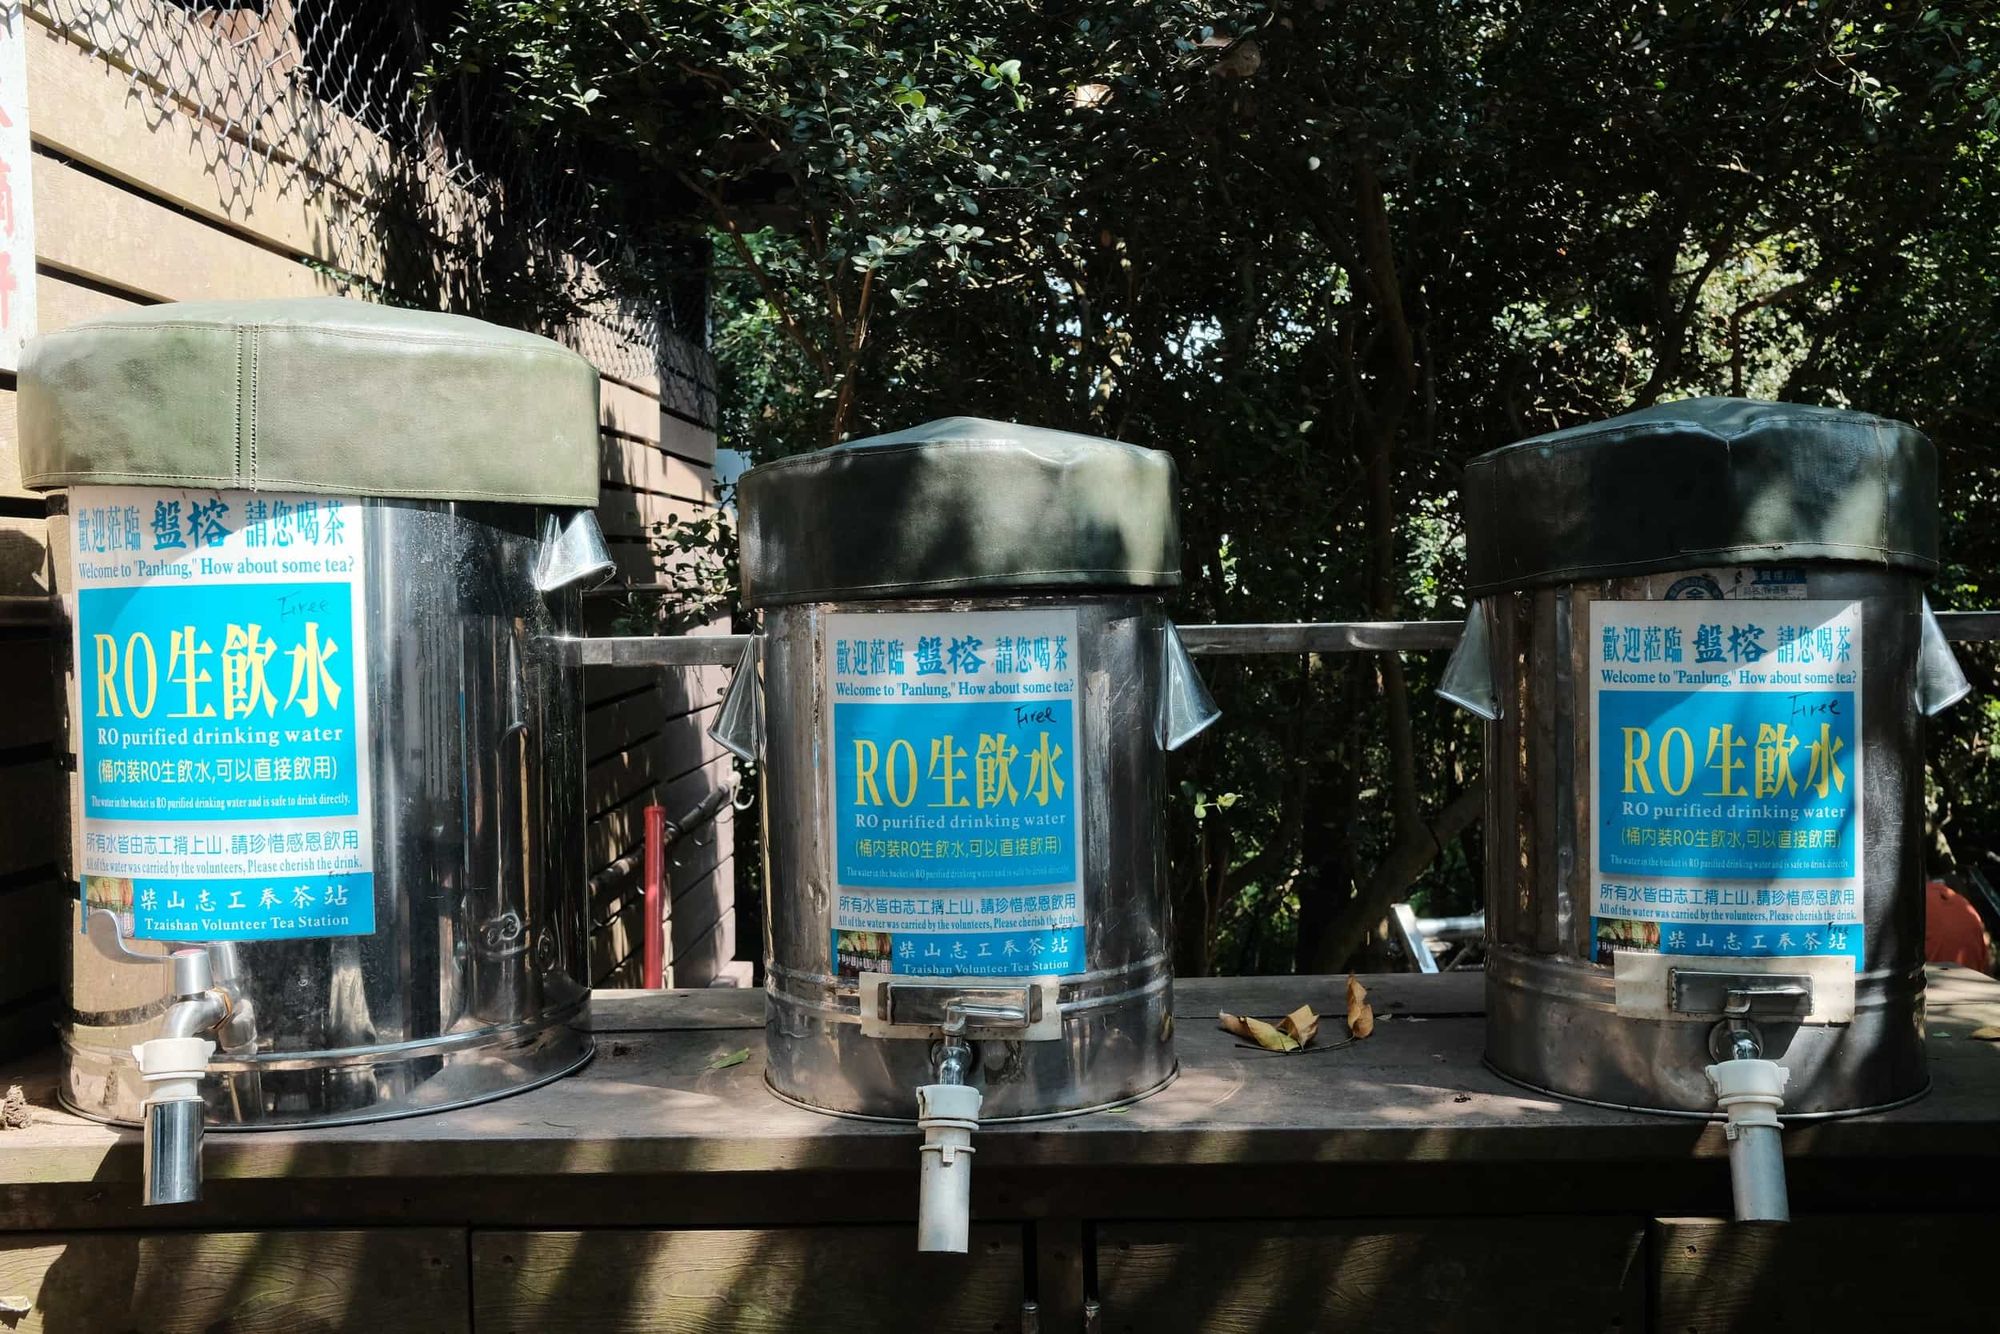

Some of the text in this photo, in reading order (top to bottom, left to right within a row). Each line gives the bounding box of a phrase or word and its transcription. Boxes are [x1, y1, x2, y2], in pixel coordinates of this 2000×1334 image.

[245, 499, 345, 548] 請您喝茶
[79, 562, 119, 579] Welcome
[121, 563, 131, 577] to
[201, 557, 233, 575] How
[237, 557, 278, 574] about
[282, 560, 321, 573] some
[326, 555, 354, 573] tea?
[1777, 625, 1851, 663] 請您喝茶
[996, 635, 1067, 673] 請您喝茶
[1601, 669, 1655, 683] Welcome
[1659, 671, 1671, 684] to
[1739, 670, 1769, 684] How
[1770, 670, 1802, 684] about
[1804, 674, 1834, 684] some
[1836, 670, 1856, 684] tea?
[836, 682, 881, 696] Welcome
[883, 684, 894, 696] to
[959, 682, 985, 695] How
[988, 681, 1020, 695] about
[1023, 684, 1052, 694] some
[1054, 679, 1074, 692] tea?
[98, 726, 343, 749] RO purified drinking water
[195, 797, 225, 810] drinking
[226, 799, 247, 807] water
[248, 796, 261, 807] and
[263, 796, 269, 807] is
[271, 796, 286, 806] safe
[288, 796, 295, 806] to
[297, 794, 317, 806] drink
[1623, 801, 1846, 821] RO purified drinking water
[856, 813, 1066, 832] RO purified drinking water
[128, 864, 141, 874] was
[142, 861, 168, 874] carried
[170, 861, 180, 877] by
[181, 860, 195, 874] the
[248, 859, 277, 873] Please
[280, 858, 314, 872] cherish
[317, 857, 331, 870] the
[1611, 854, 1622, 864] The
[1623, 857, 1640, 865] water
[1647, 857, 1658, 866] the
[1689, 858, 1700, 867] RO
[1791, 859, 1802, 868] safe
[1803, 860, 1809, 868] to
[1810, 859, 1827, 868] drink
[916, 869, 926, 878] RO
[1599, 903, 1609, 914] All
[1611, 904, 1619, 914] of
[1619, 905, 1631, 915] the
[1632, 908, 1653, 917] water
[1655, 910, 1669, 918] was
[1671, 908, 1698, 919] carried
[1700, 909, 1709, 922] by
[1711, 909, 1723, 920] the
[1769, 910, 1793, 921] Please
[1795, 910, 1822, 921] cherish
[1824, 910, 1835, 920] the
[144, 914, 349, 931] Tzaishan Volunteer Tea Station
[839, 915, 847, 926] All
[848, 916, 855, 926] of
[855, 917, 865, 927] the
[867, 919, 885, 928] water
[887, 921, 899, 929] was
[901, 918, 926, 929] carried
[928, 919, 937, 931] by
[938, 919, 949, 930] the
[994, 917, 1017, 928] Please
[1018, 916, 1045, 927] cherish
[903, 960, 1069, 974] Tzaishan Volunteer Tea Station
